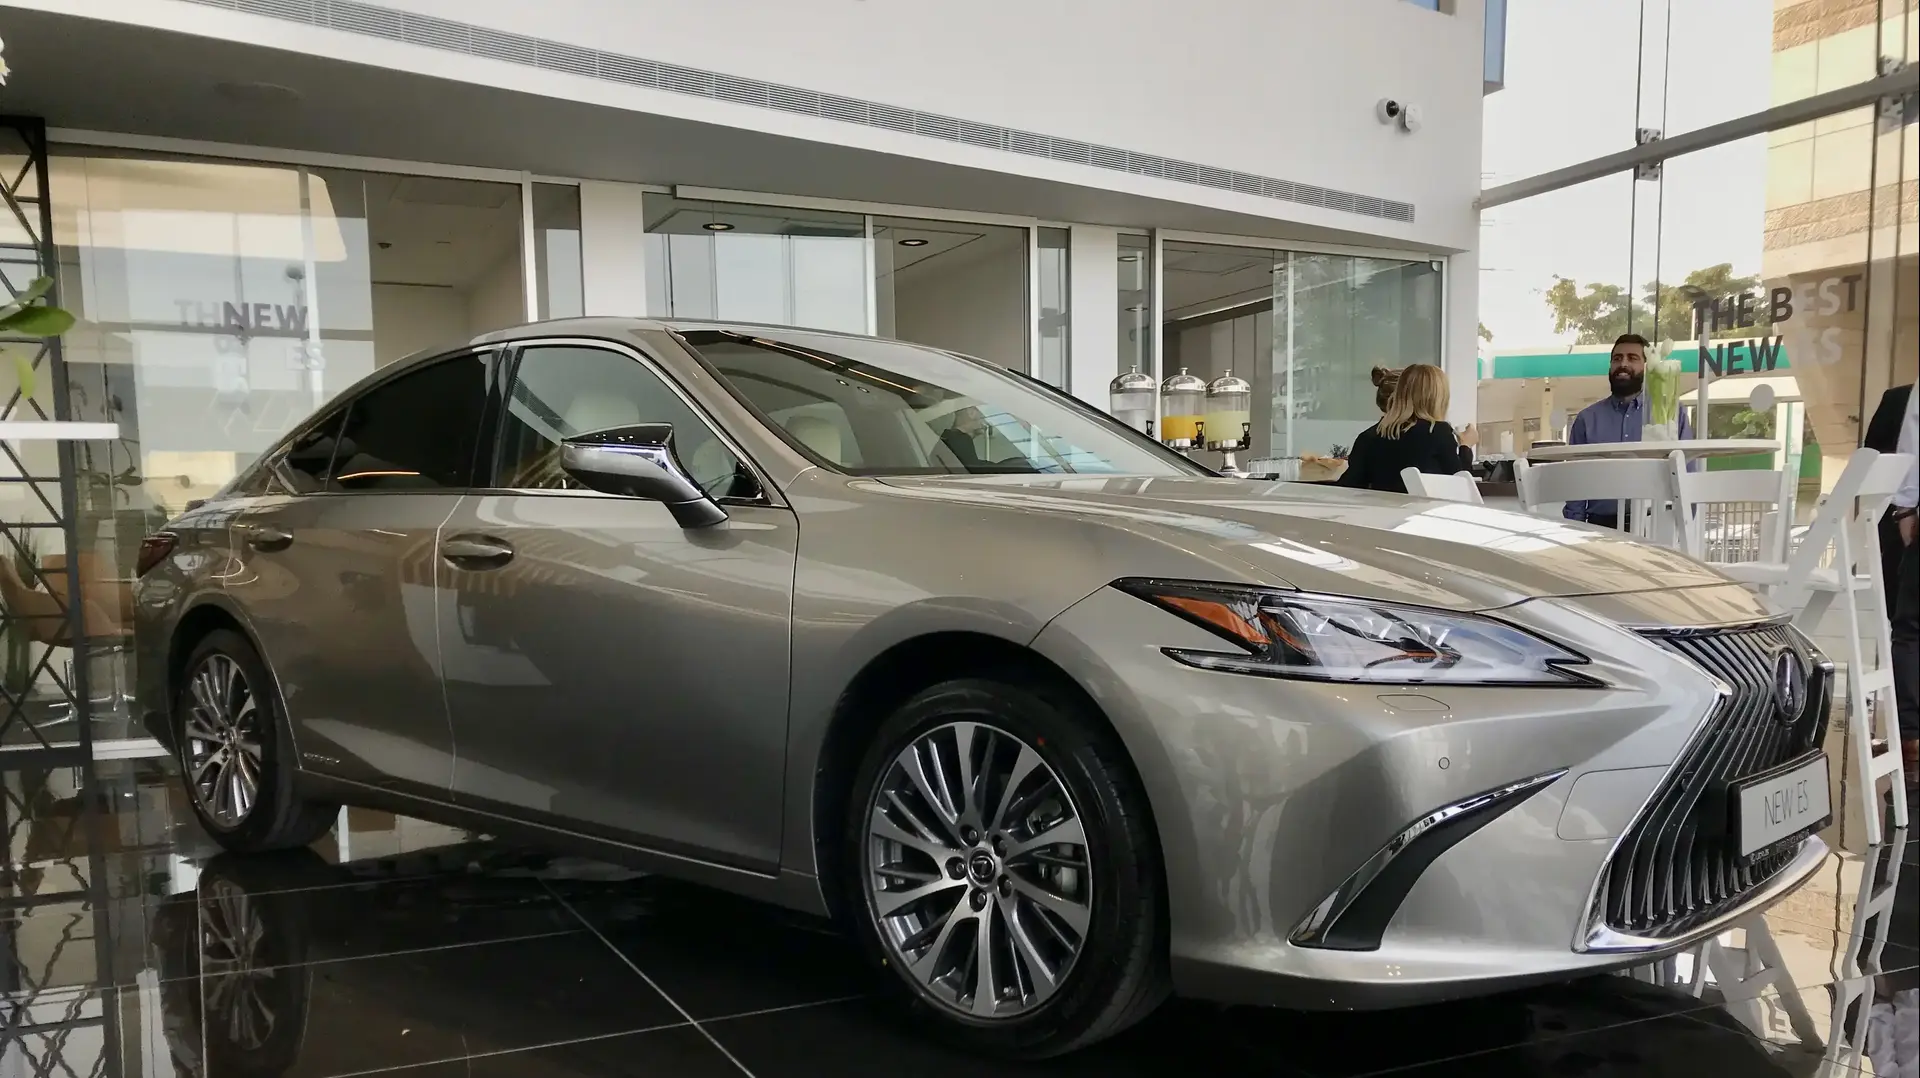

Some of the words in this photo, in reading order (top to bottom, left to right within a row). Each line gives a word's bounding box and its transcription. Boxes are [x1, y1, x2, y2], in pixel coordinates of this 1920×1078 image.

[1692, 292, 1755, 335] THE
[1770, 274, 1863, 324] BEST
[1698, 335, 1784, 379] NEW
[1764, 787, 1794, 829] NEW
[1797, 779, 1809, 814] ES
